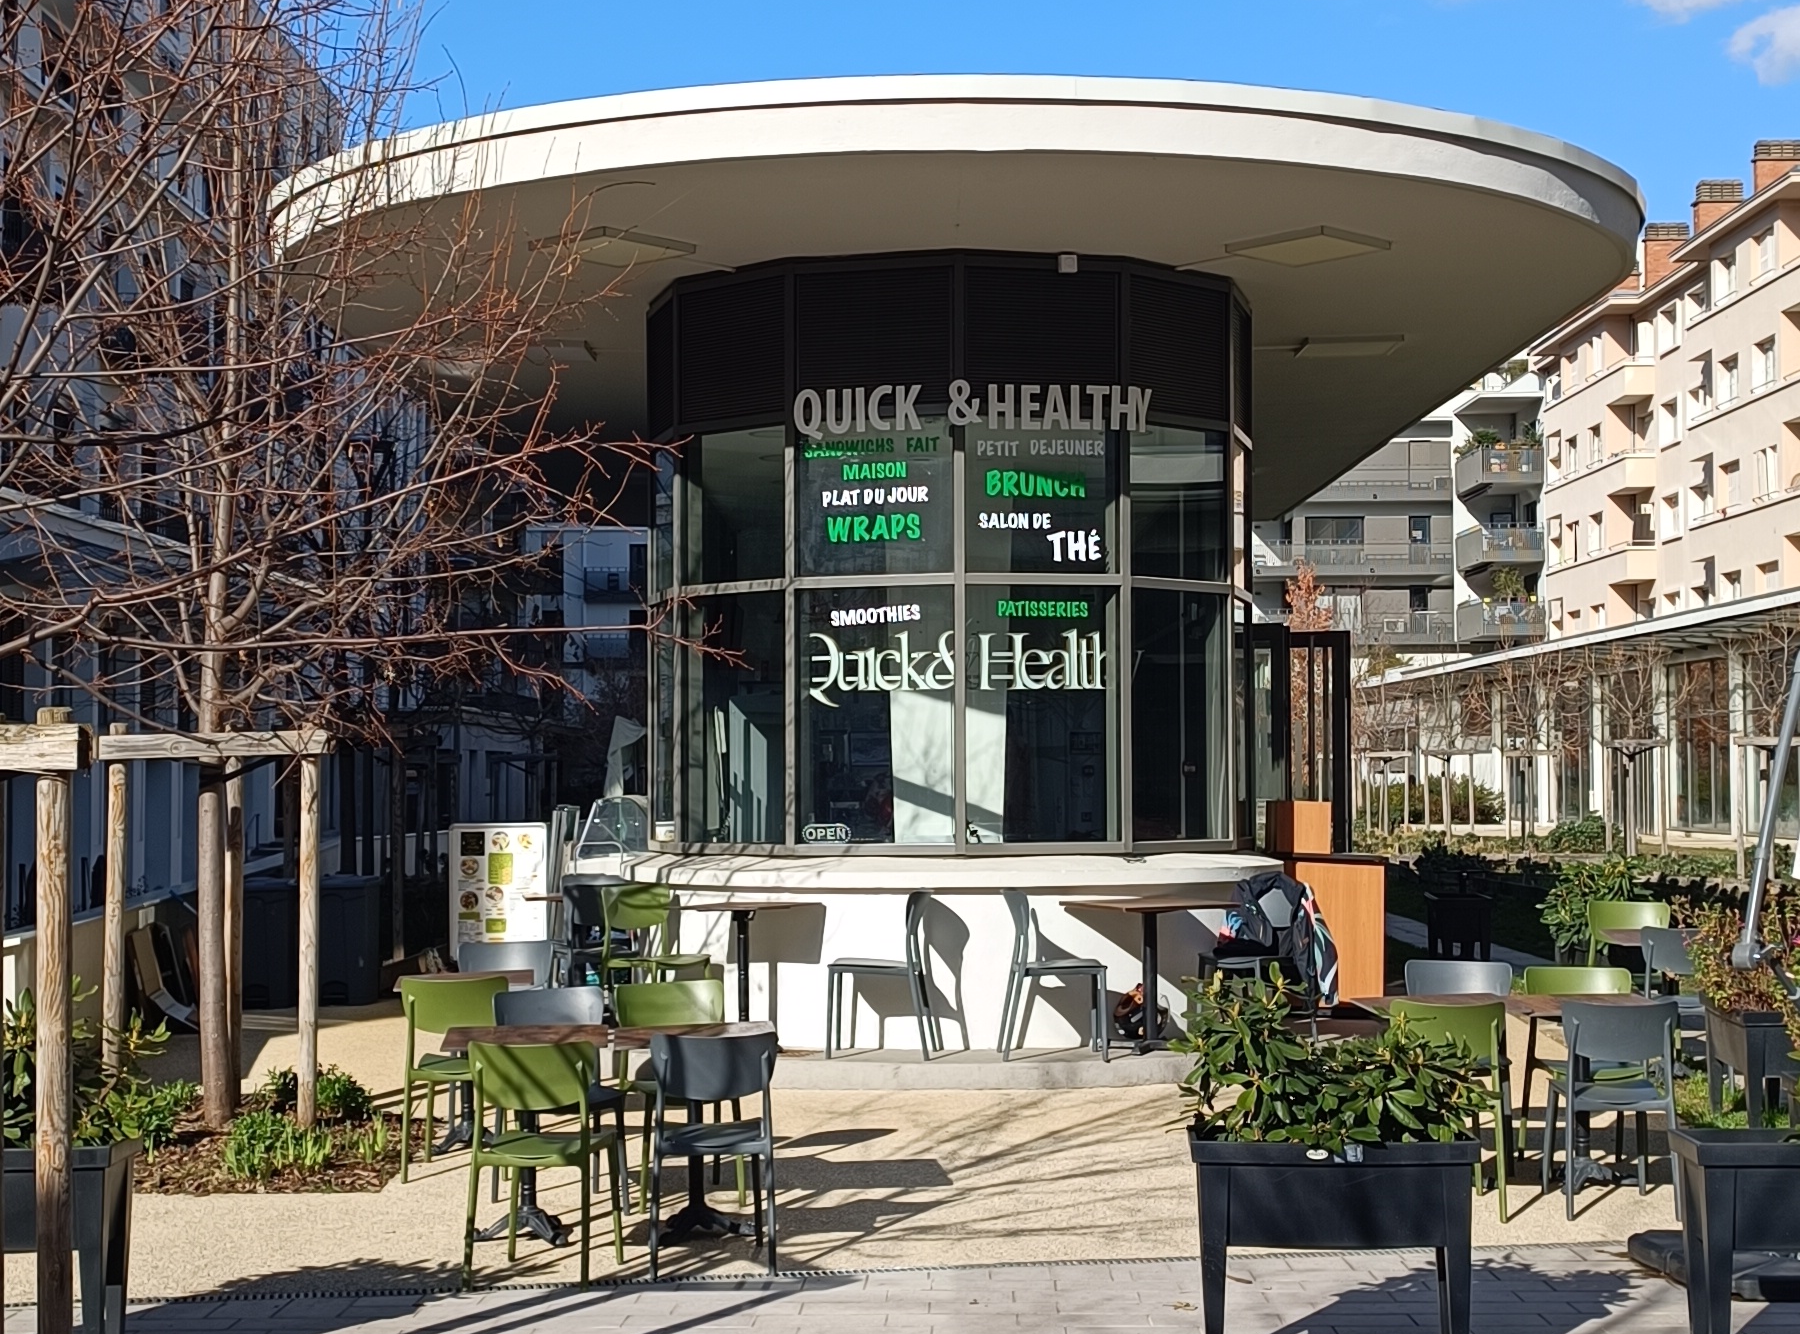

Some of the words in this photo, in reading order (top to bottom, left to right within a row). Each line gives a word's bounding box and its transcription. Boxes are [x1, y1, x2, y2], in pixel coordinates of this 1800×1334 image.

[793, 384, 923, 440] QUICK
[805, 437, 894, 457] SANDWICHS
[906, 436, 940, 453] FAIT
[977, 440, 1019, 456] PETIT
[1030, 439, 1105, 456] DEJEUNER
[843, 461, 907, 480] MAISON
[986, 469, 1086, 498] BRUNCH
[822, 489, 860, 507] PLAT
[863, 488, 885, 505] DU
[887, 485, 929, 504] JOUR
[827, 513, 921, 543] WRAPS
[978, 513, 1029, 529] SALON
[1032, 513, 1051, 529] DE
[1046, 529, 1101, 562] THÉ
[830, 604, 921, 627] SMOOTHIES
[998, 600, 1088, 617] PATISSERIES
[805, 827, 846, 840] OPEN
